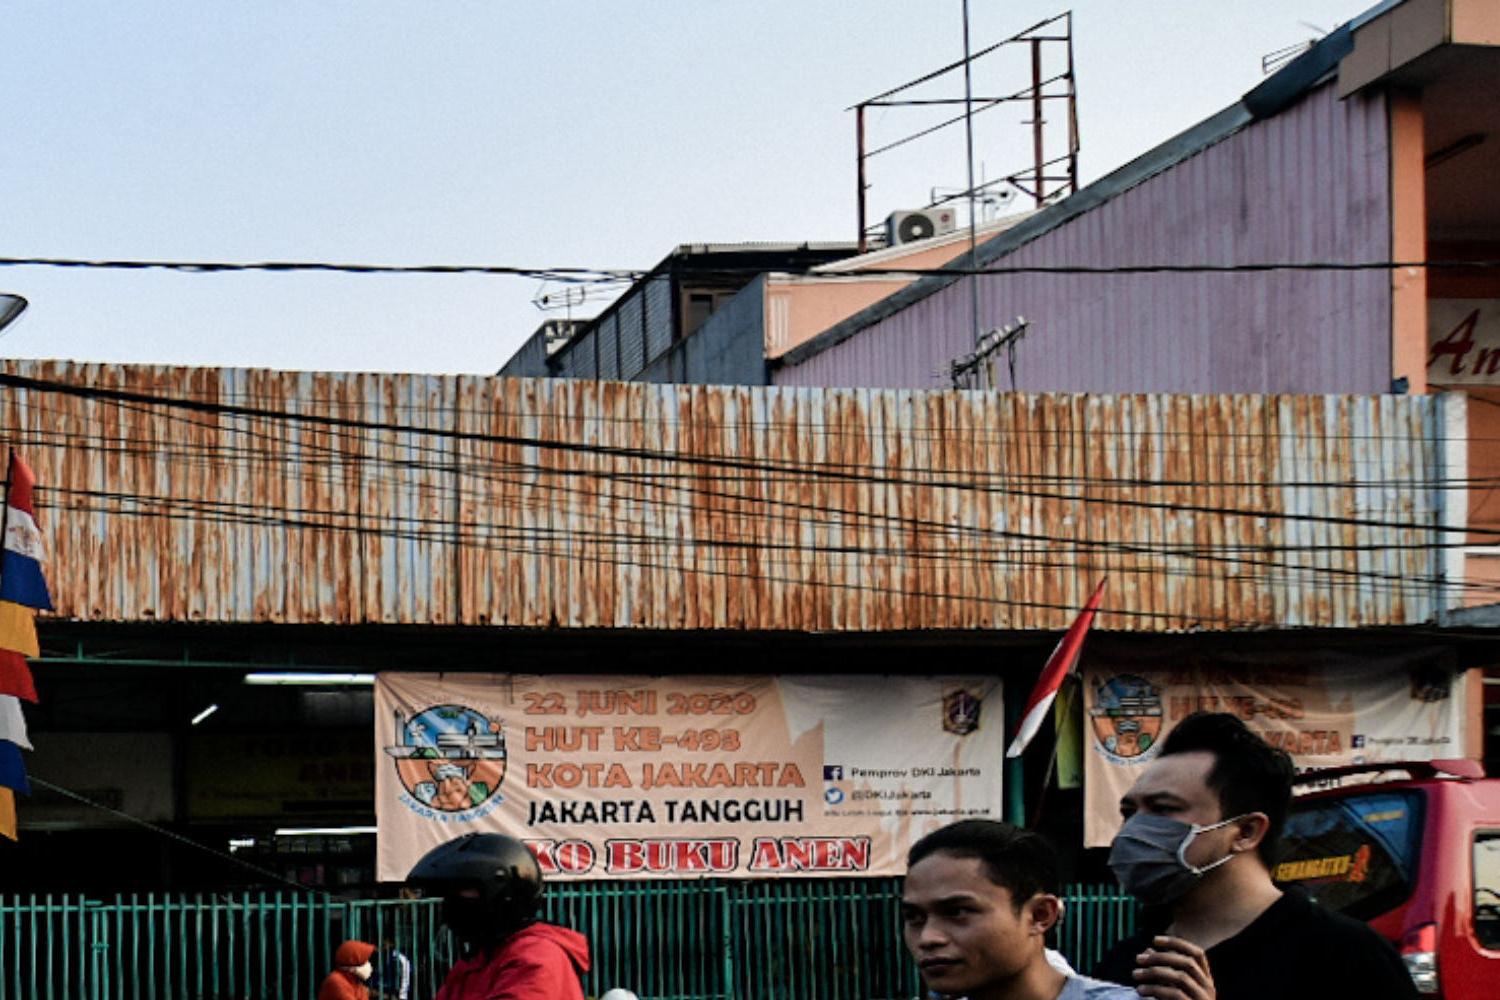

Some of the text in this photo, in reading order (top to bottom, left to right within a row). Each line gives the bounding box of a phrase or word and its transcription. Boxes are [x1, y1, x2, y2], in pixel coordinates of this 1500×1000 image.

[523, 692, 567, 715] 22
[575, 690, 658, 717] JUNI
[666, 692, 757, 716] 2020
[525, 726, 741, 752] HUT KE-493
[526, 762, 806, 790] KOTA JAKARTA
[938, 766, 981, 777] Jakarta
[527, 799, 804, 827] JAKARTA TANGGUH
[524, 836, 872, 876] KO BUKU ANEN
